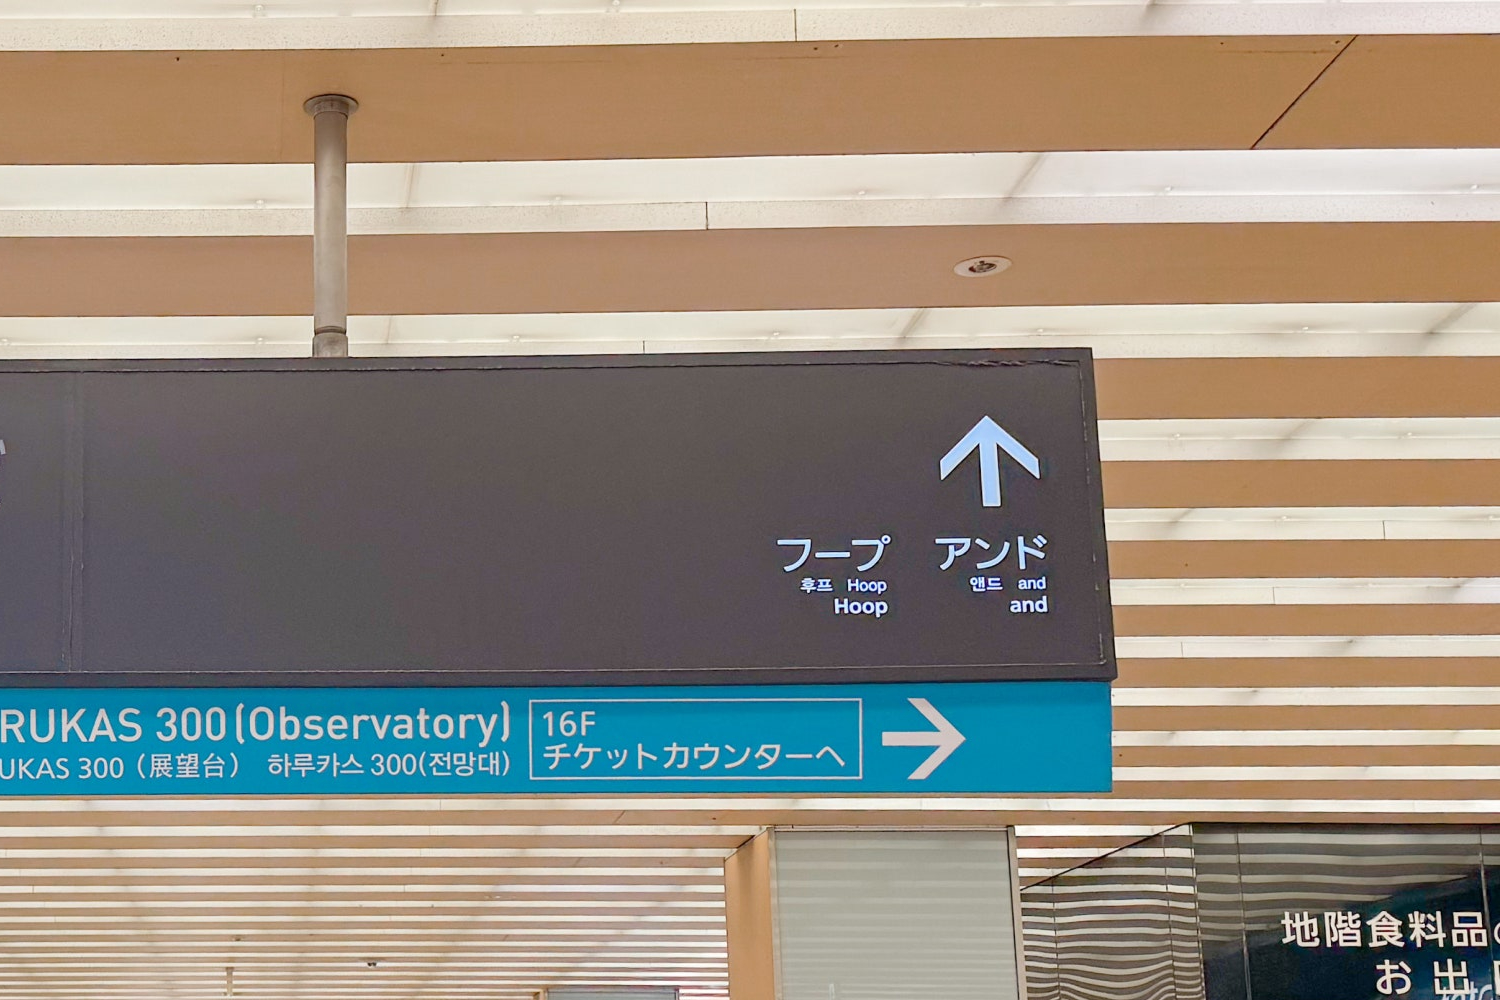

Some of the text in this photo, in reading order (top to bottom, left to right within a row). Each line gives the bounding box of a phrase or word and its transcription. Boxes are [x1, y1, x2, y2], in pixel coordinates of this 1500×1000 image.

[777, 534, 892, 572] フープ
[935, 534, 1048, 571] アンド
[847, 579, 888, 594] Hoop
[1017, 576, 1047, 590] and
[834, 598, 889, 618] Hoop
[1009, 596, 1048, 613] and
[543, 710, 596, 737] 16F
[267, 753, 363, 778] 하루카스
[543, 741, 846, 770] チケットカウンターへ
[1281, 910, 1500, 948] 地階食料品
